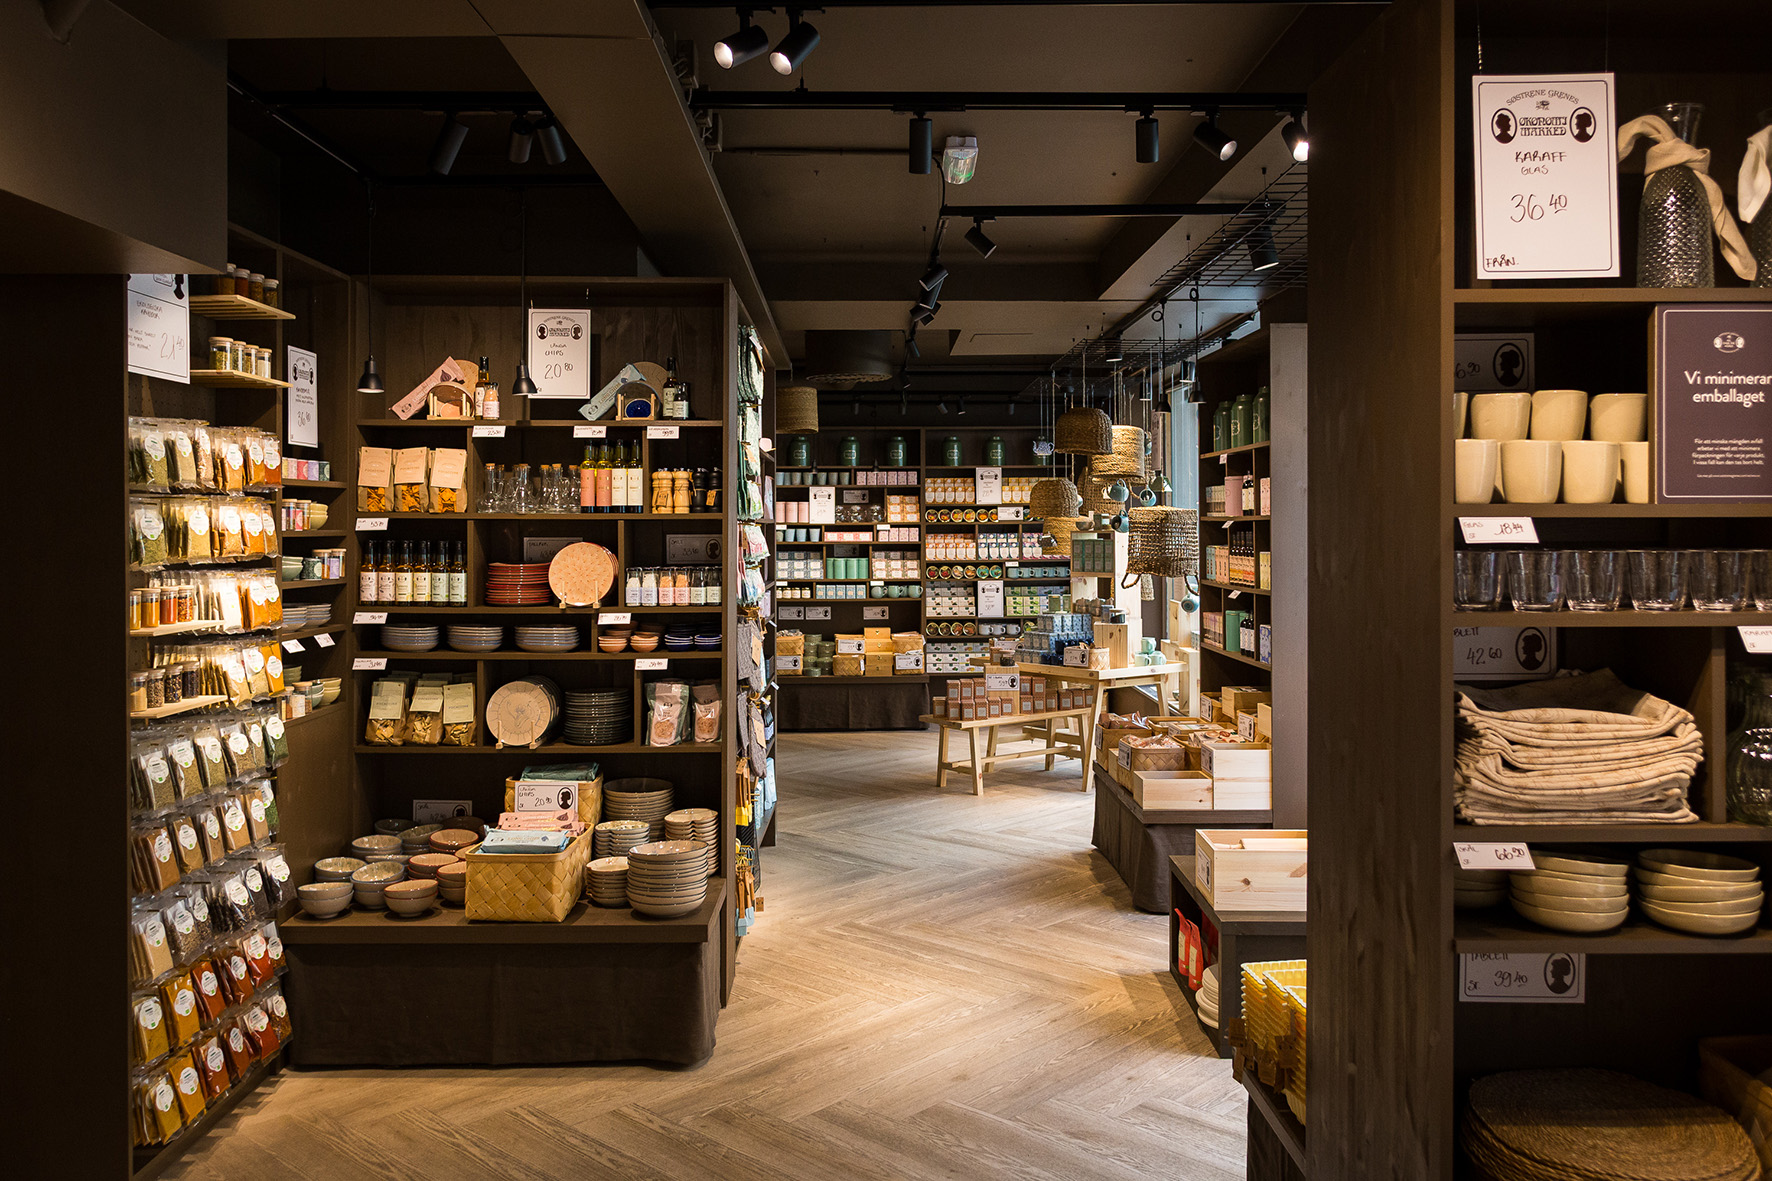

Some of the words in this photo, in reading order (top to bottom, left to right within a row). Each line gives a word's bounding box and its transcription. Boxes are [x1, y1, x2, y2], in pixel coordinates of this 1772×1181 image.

[1506, 89, 1546, 106] SØSTRENE
[1548, 90, 1579, 104] GRENES
[1520, 127, 1566, 136] MARKED
[1515, 150, 1566, 162] KARAFF
[1521, 164, 1548, 176] GLAS
[1510, 194, 1544, 222] 36
[1549, 194, 1568, 213] 40
[544, 364, 562, 379] 20
[1684, 370, 1700, 384] Vi
[1704, 370, 1772, 384] minimerar
[1692, 388, 1765, 408] emballaget
[1466, 648, 1486, 664] 42
[1488, 647, 1502, 659] 60
[1494, 970, 1512, 988] 39
